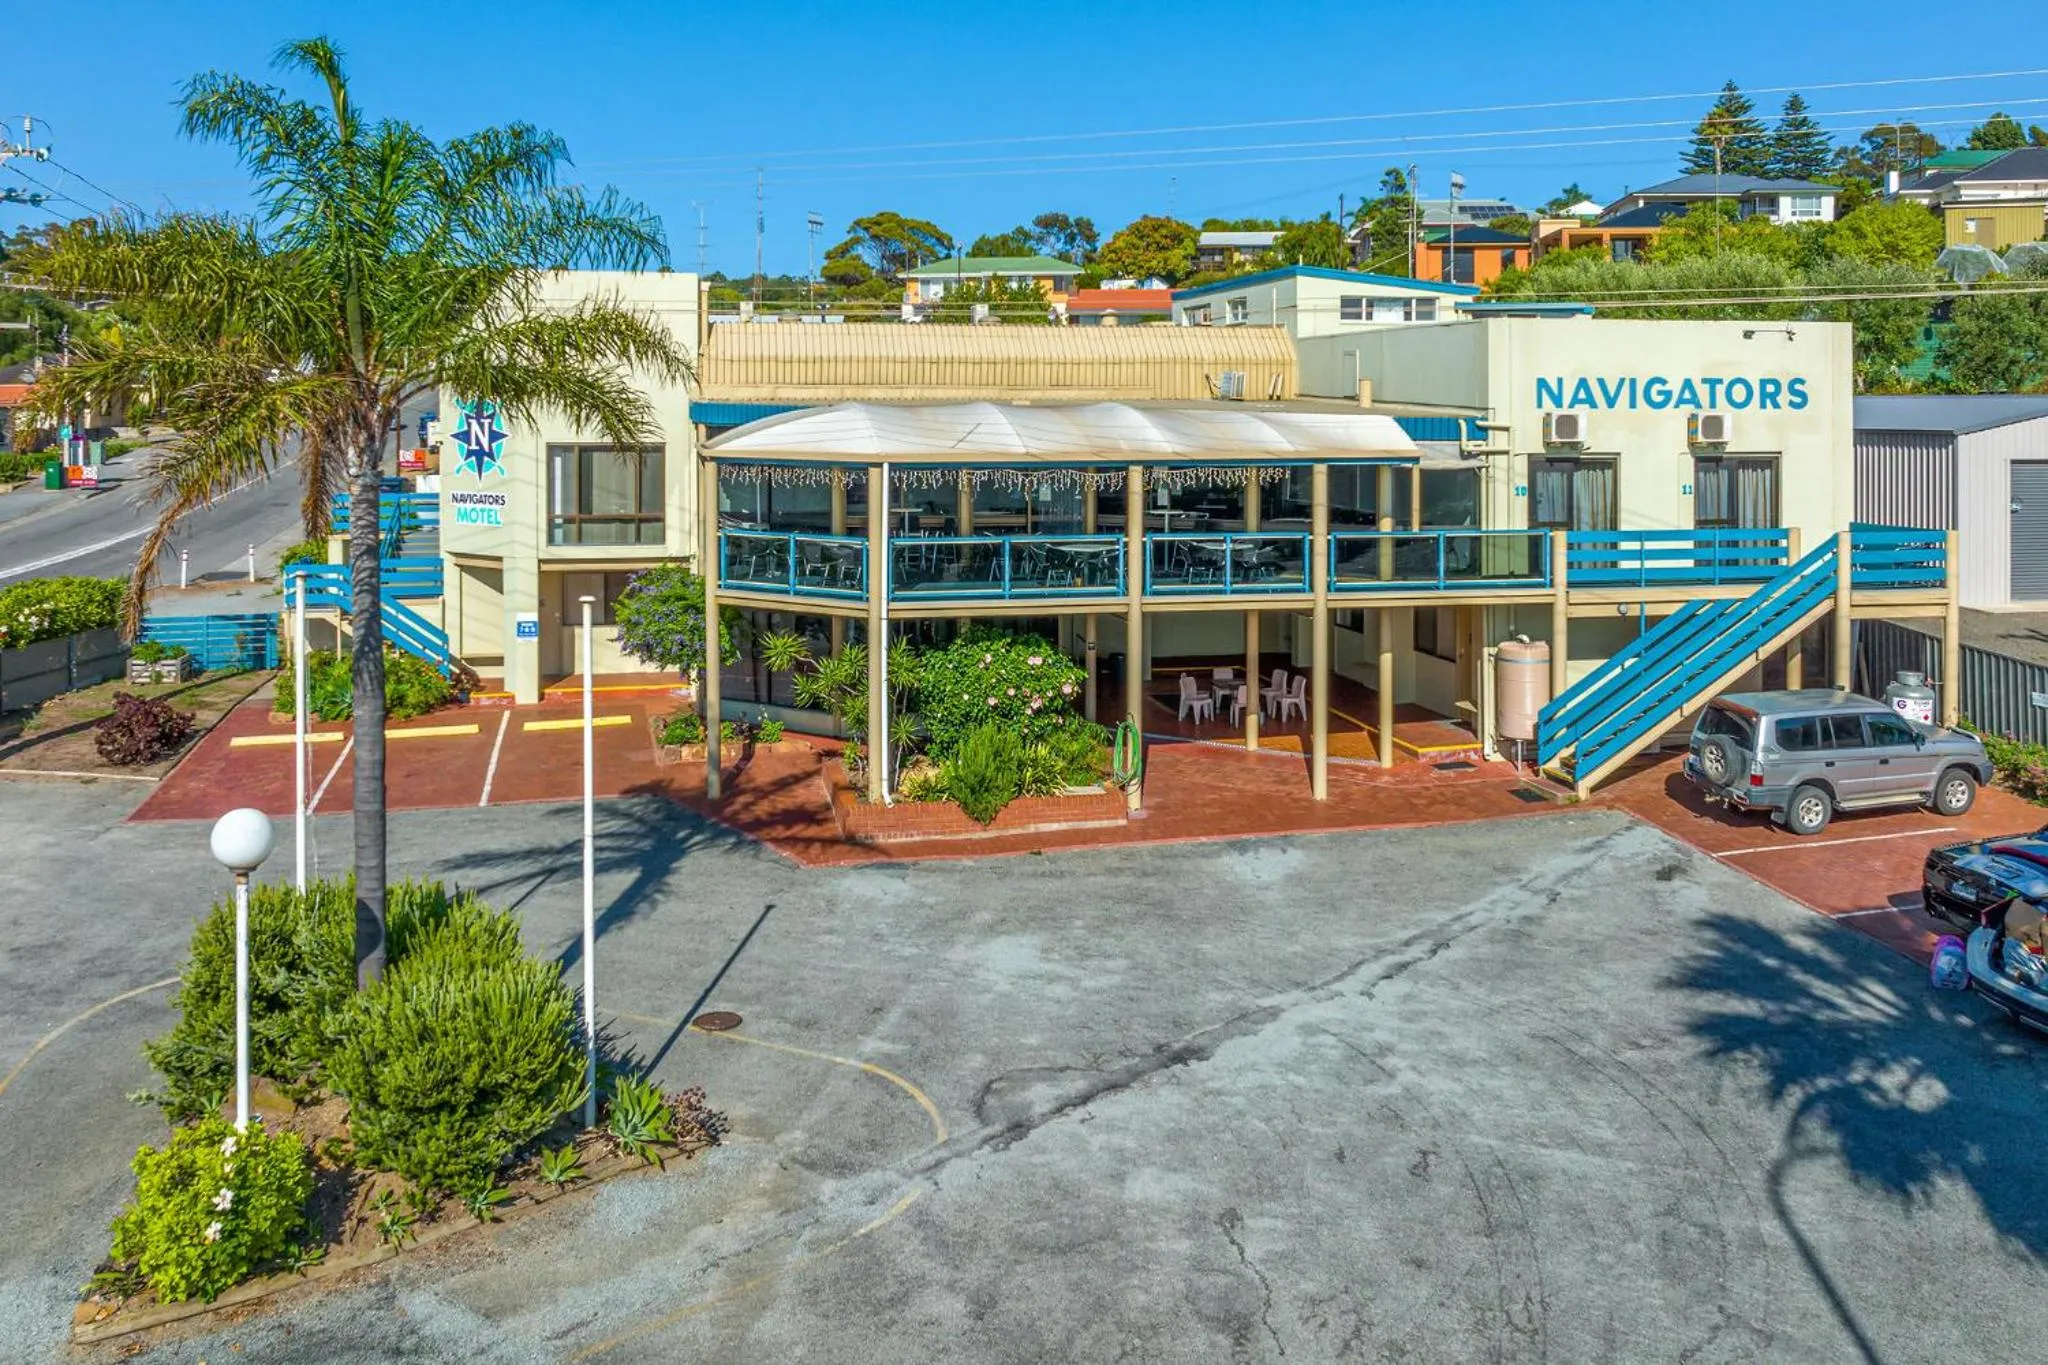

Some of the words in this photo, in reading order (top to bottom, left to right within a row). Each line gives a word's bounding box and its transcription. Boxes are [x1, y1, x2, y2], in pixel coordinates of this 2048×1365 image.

[1536, 377, 1809, 410] NAVIGATORS
[468, 419, 492, 452] N
[1514, 485, 1528, 497] 10
[1681, 484, 1693, 495] 11
[451, 492, 506, 506] NAVIGATORS
[456, 507, 501, 524] MOTEL
